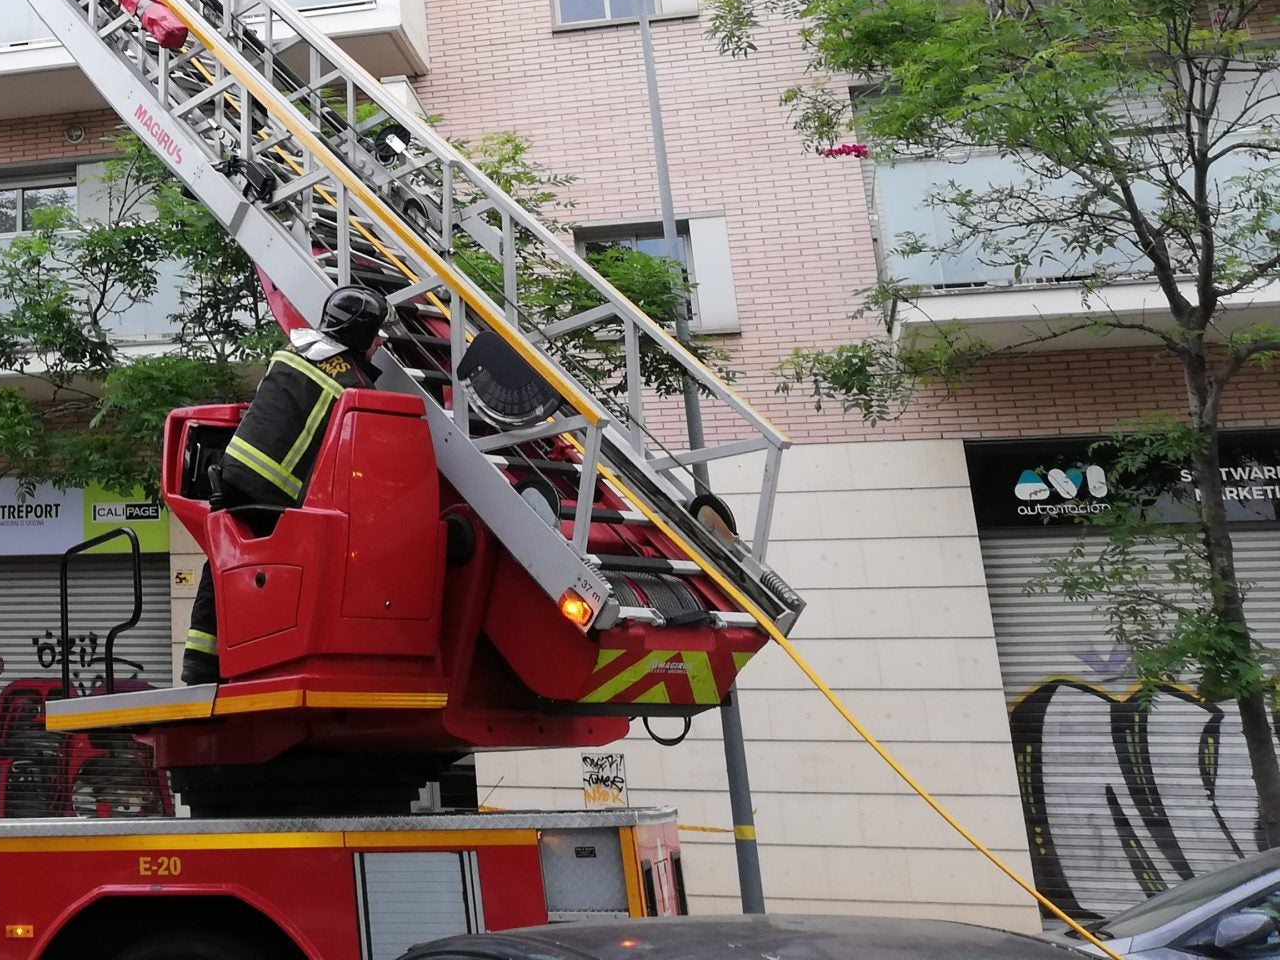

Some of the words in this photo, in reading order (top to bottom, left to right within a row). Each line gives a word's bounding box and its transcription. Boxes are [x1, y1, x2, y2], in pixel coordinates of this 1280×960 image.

[134, 103, 183, 165] MAGIRUS
[581, 580, 593, 592] 37
[592, 591, 601, 603] m
[139, 856, 182, 876] E-20
